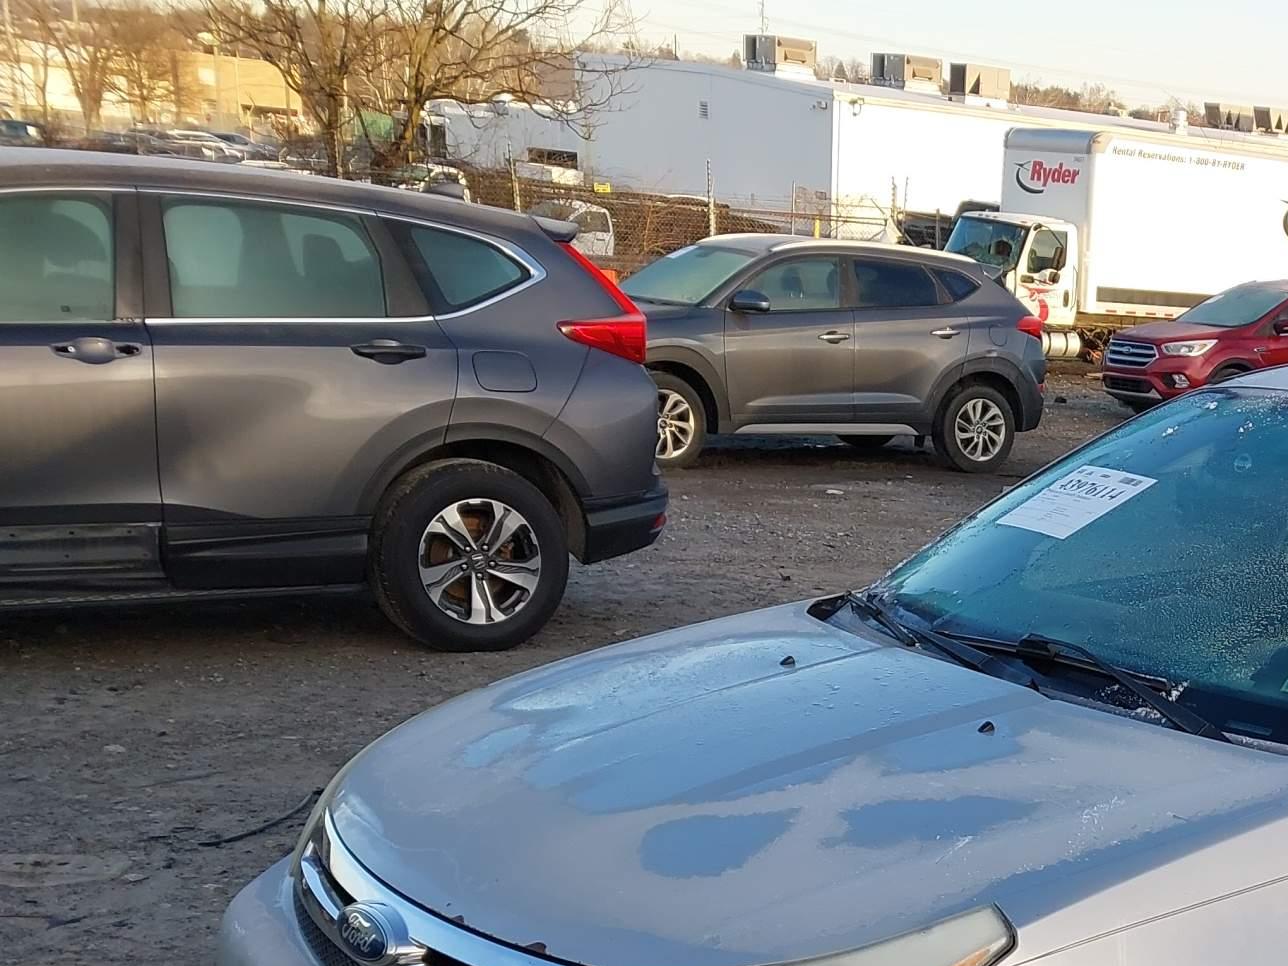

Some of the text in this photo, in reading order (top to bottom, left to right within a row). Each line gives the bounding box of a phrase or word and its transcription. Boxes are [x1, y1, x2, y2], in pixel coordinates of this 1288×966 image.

[1112, 145, 1136, 157] Rental
[1030, 159, 1080, 188] Ryder
[341, 912, 377, 953] Ford
